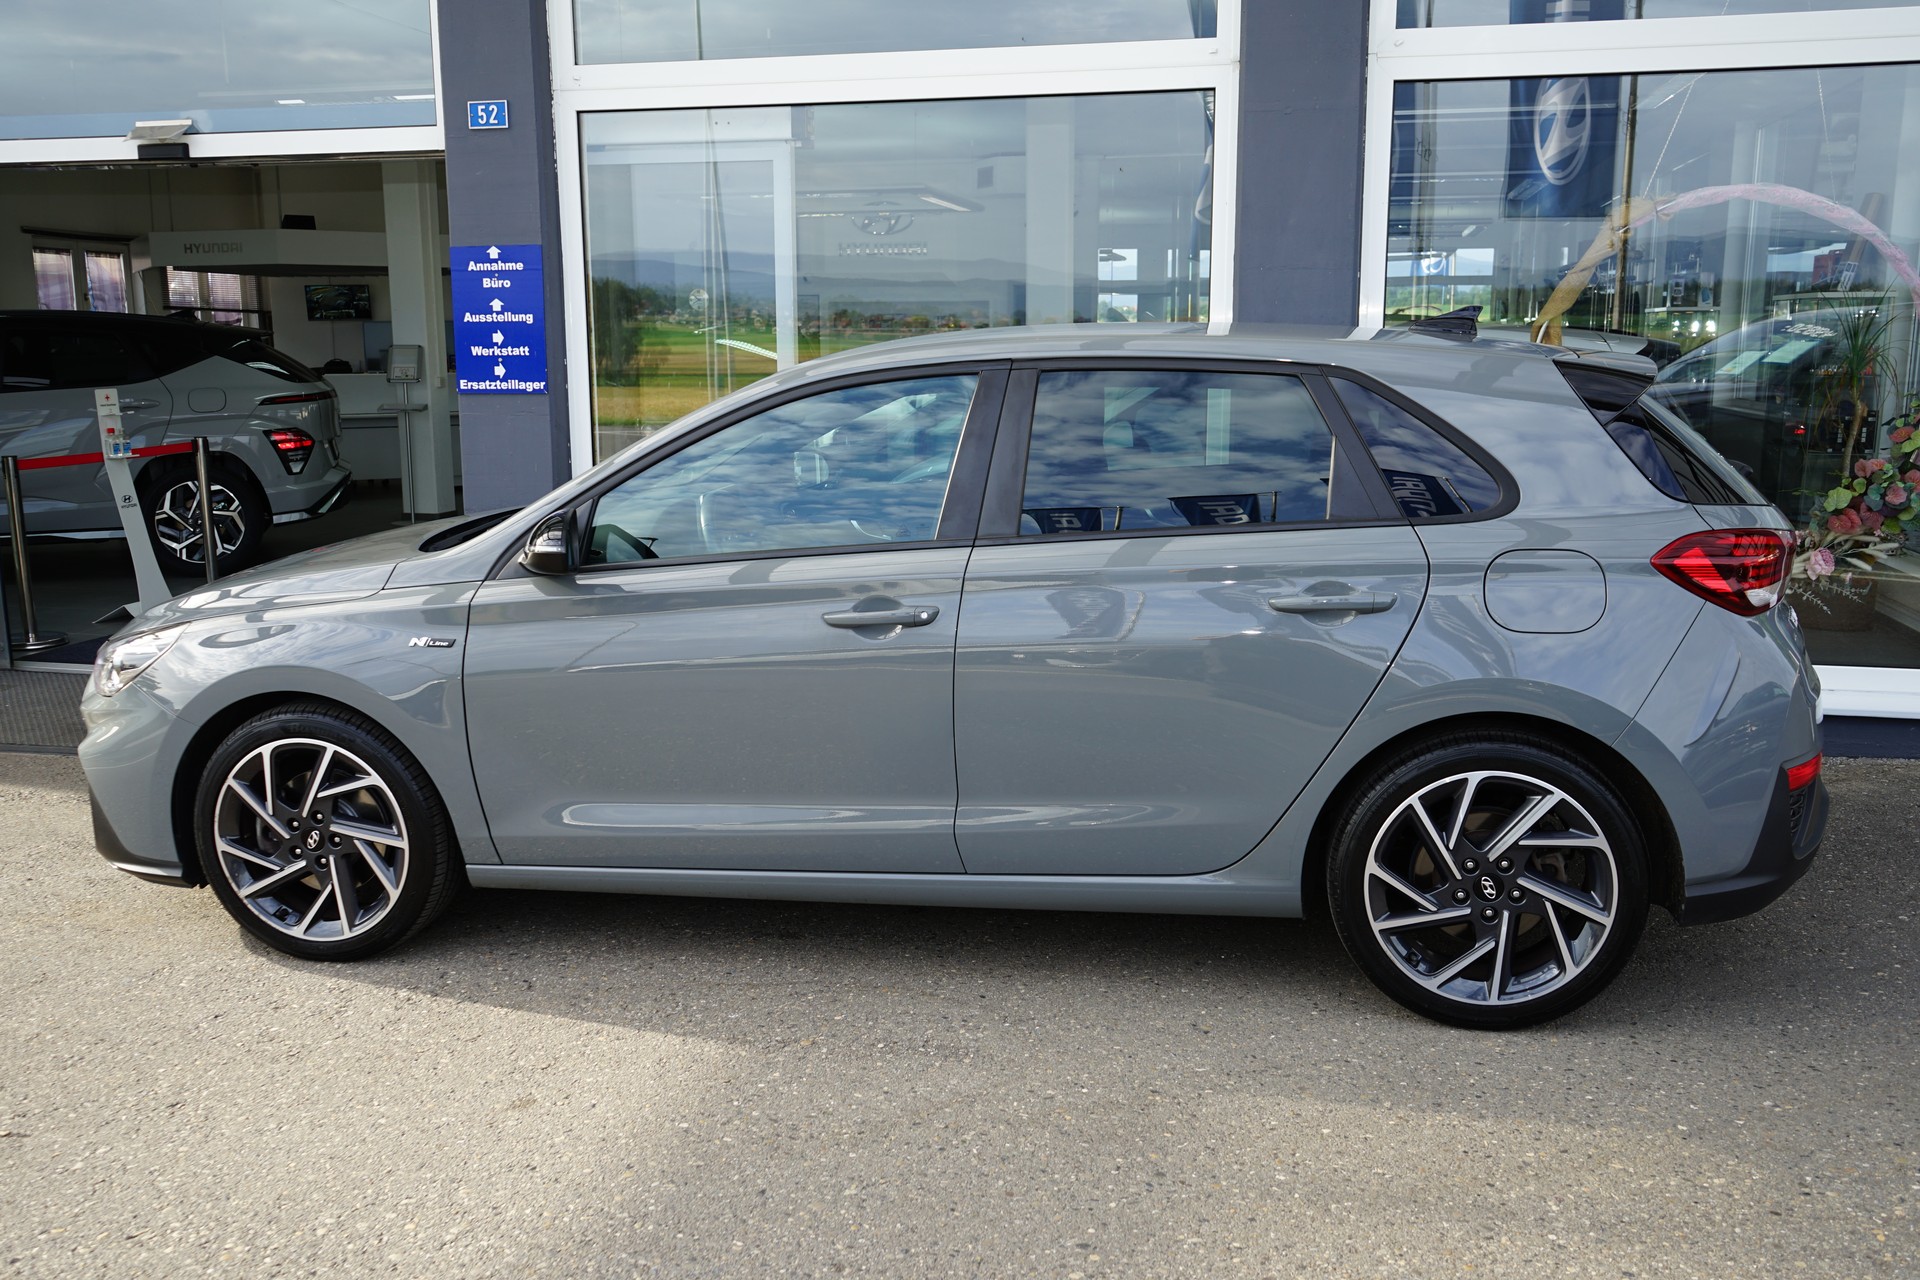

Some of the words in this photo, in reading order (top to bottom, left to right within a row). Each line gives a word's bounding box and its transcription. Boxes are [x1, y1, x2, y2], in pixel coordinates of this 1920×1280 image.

[477, 104, 498, 124] 52
[183, 242, 243, 254] HYUNDAI
[467, 260, 524, 271] Annahme
[482, 277, 511, 288] Büro
[463, 312, 534, 324] Ausstellung
[470, 346, 530, 356] Werkstatt
[459, 379, 546, 392] Ersatzteillager
